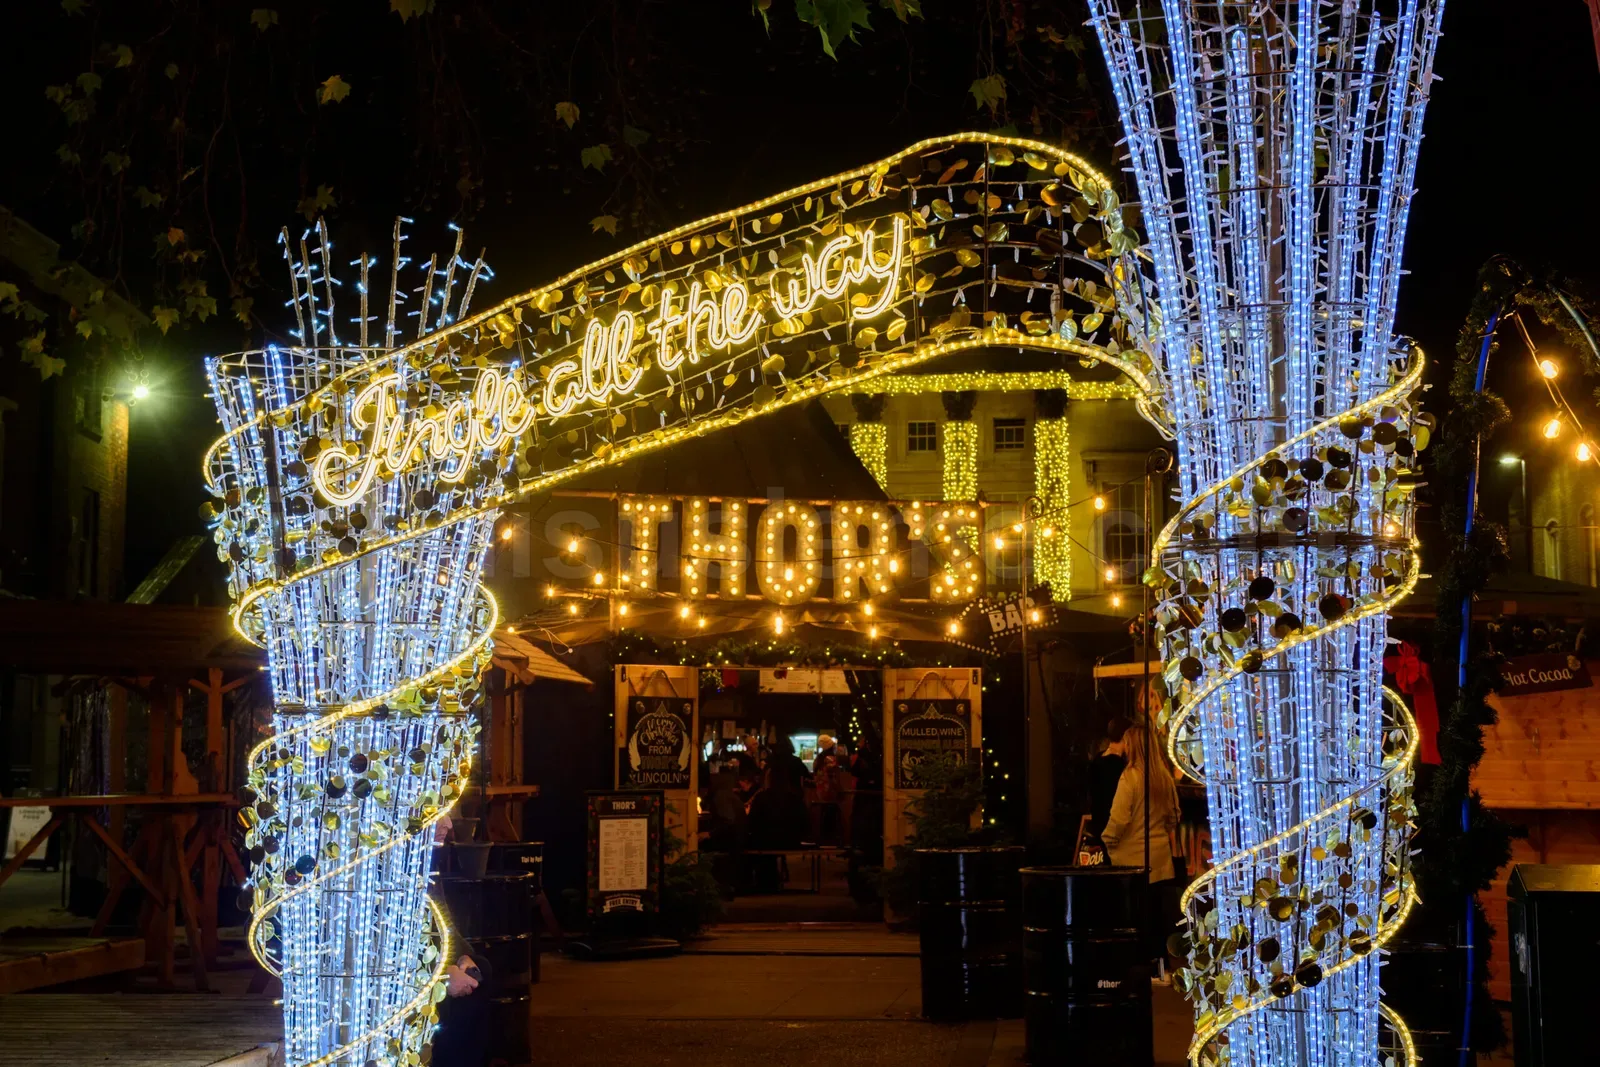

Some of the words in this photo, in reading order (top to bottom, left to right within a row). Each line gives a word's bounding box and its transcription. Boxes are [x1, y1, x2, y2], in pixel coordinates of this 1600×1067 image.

[312, 366, 535, 506] Jingle
[543, 310, 642, 417] all
[647, 281, 763, 371] the
[769, 212, 906, 320] way
[617, 495, 984, 604] THOR'S
[1528, 668, 1574, 684] Cocoa
[902, 727, 938, 736] MULLED
[940, 727, 963, 736] WINE
[648, 745, 672, 755] FROM
[611, 800, 636, 811] THOR'S
